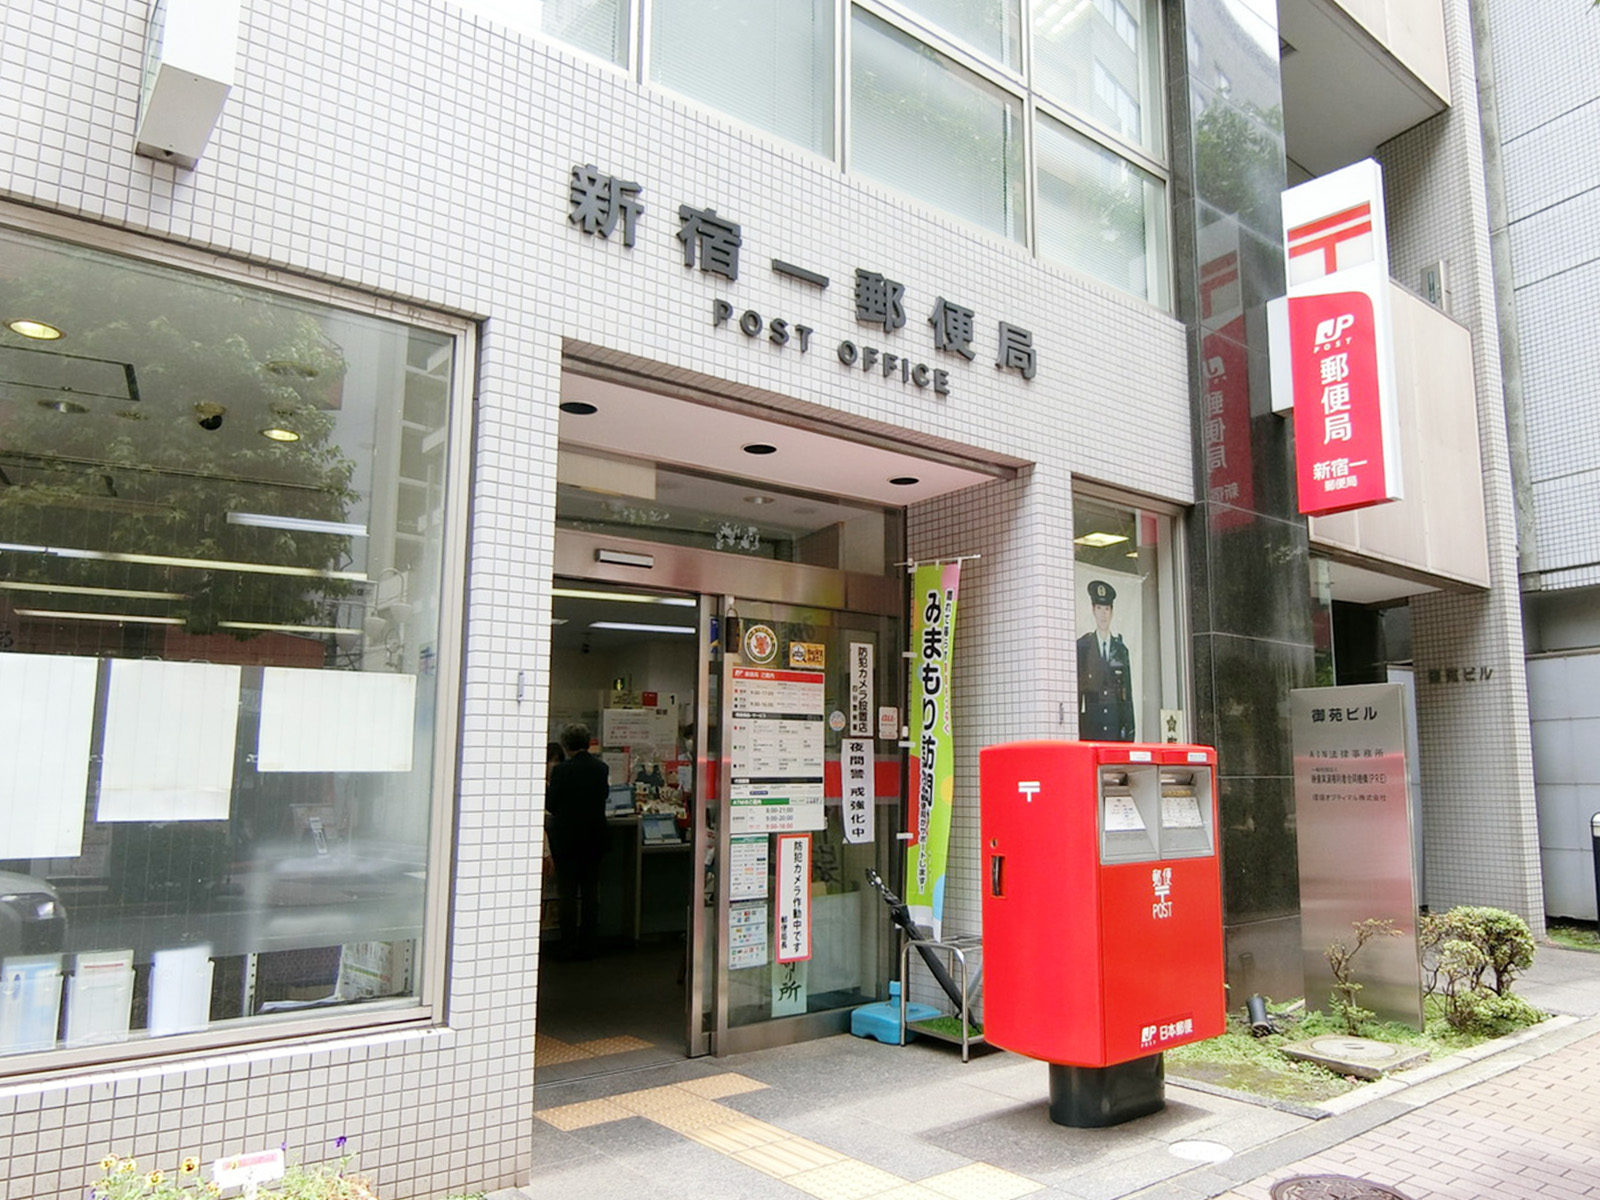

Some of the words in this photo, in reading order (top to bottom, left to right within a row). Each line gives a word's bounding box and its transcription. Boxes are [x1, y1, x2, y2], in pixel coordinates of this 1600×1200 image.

[568, 163, 1037, 380] 新宿一郵便局
[1314, 314, 1354, 346] JP
[713, 298, 814, 354] POST
[837, 339, 951, 397] OFFICE
[1314, 337, 1353, 354] POST
[1320, 352, 1352, 446] 郵便局
[1313, 457, 1368, 481] 新宿一
[1324, 475, 1358, 493] 郵便局
[1312, 706, 1378, 723] 御苑ビル
[1152, 867, 1173, 886] 郵便
[792, 840, 803, 954] 防犯カメラ作動中です
[1152, 902, 1173, 919] POST
[1160, 1018, 1193, 1041] 日本郵便
